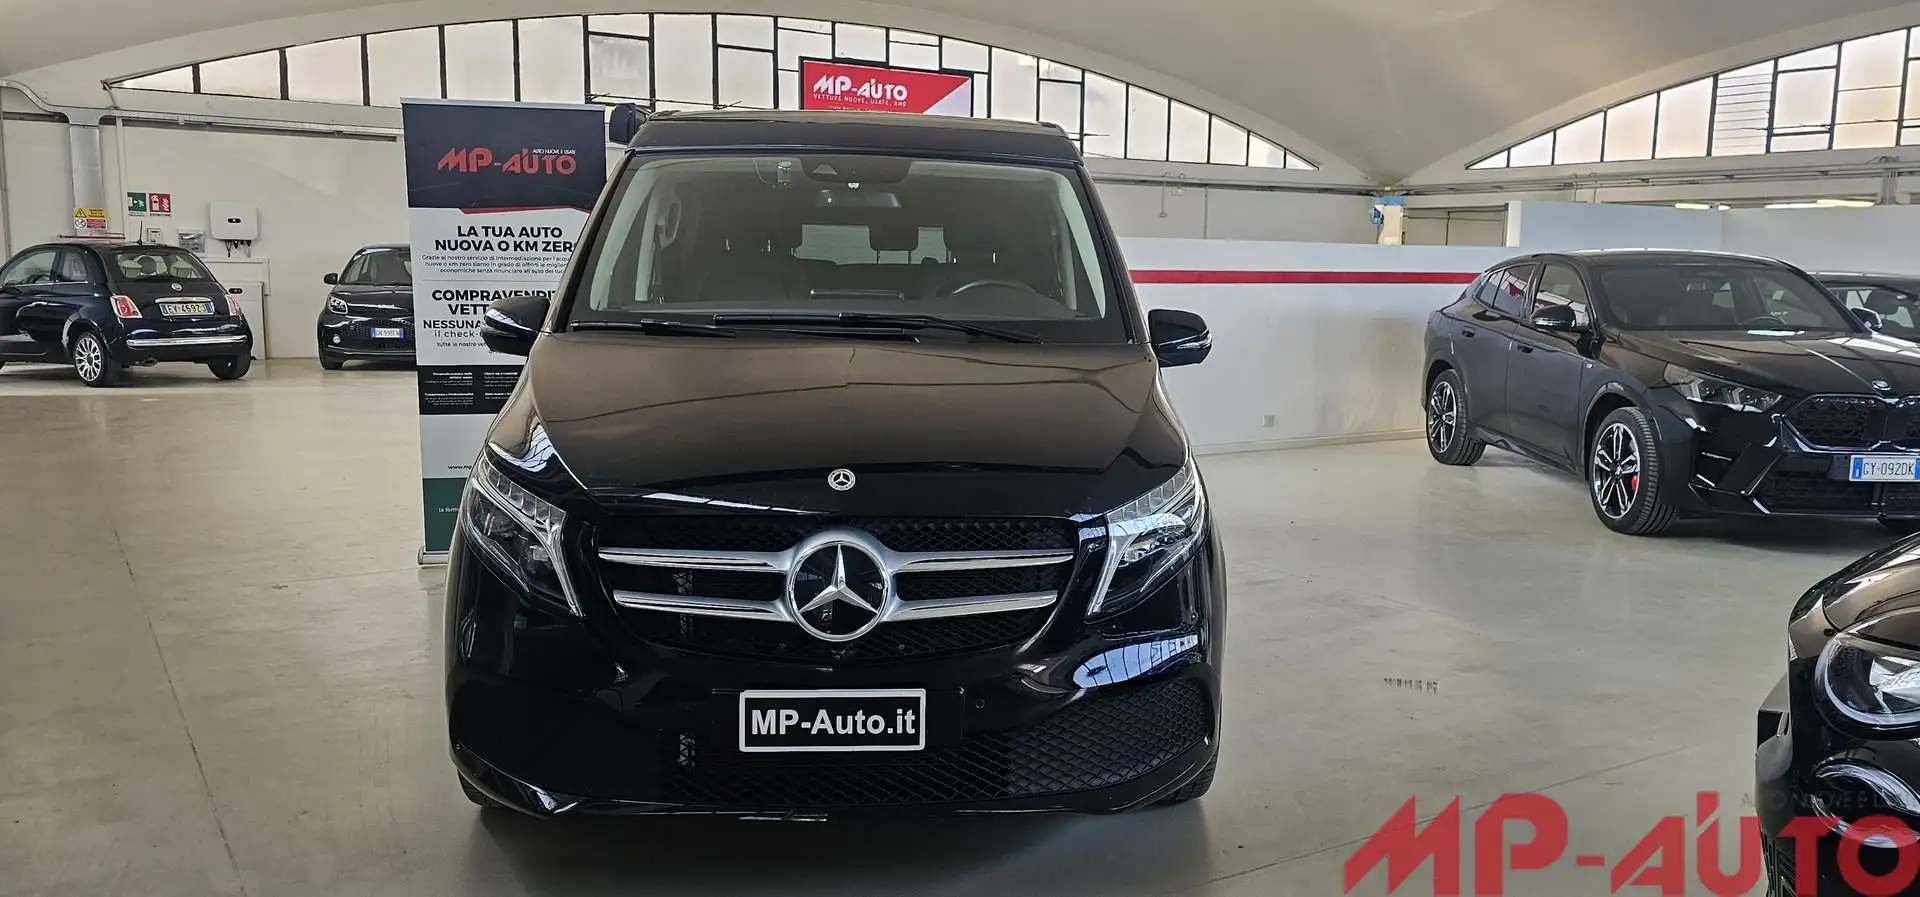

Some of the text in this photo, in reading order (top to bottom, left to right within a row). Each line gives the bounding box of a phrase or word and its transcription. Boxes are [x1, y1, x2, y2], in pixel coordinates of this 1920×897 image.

[813, 75, 908, 101] MP-AUTO
[437, 147, 577, 175] MP-AUTO
[457, 225, 563, 239] LA TUA AUTO
[435, 239, 494, 251] NUOVA
[497, 240, 510, 252] O
[513, 241, 538, 252] KM
[751, 708, 916, 735] MP-Auto.it
